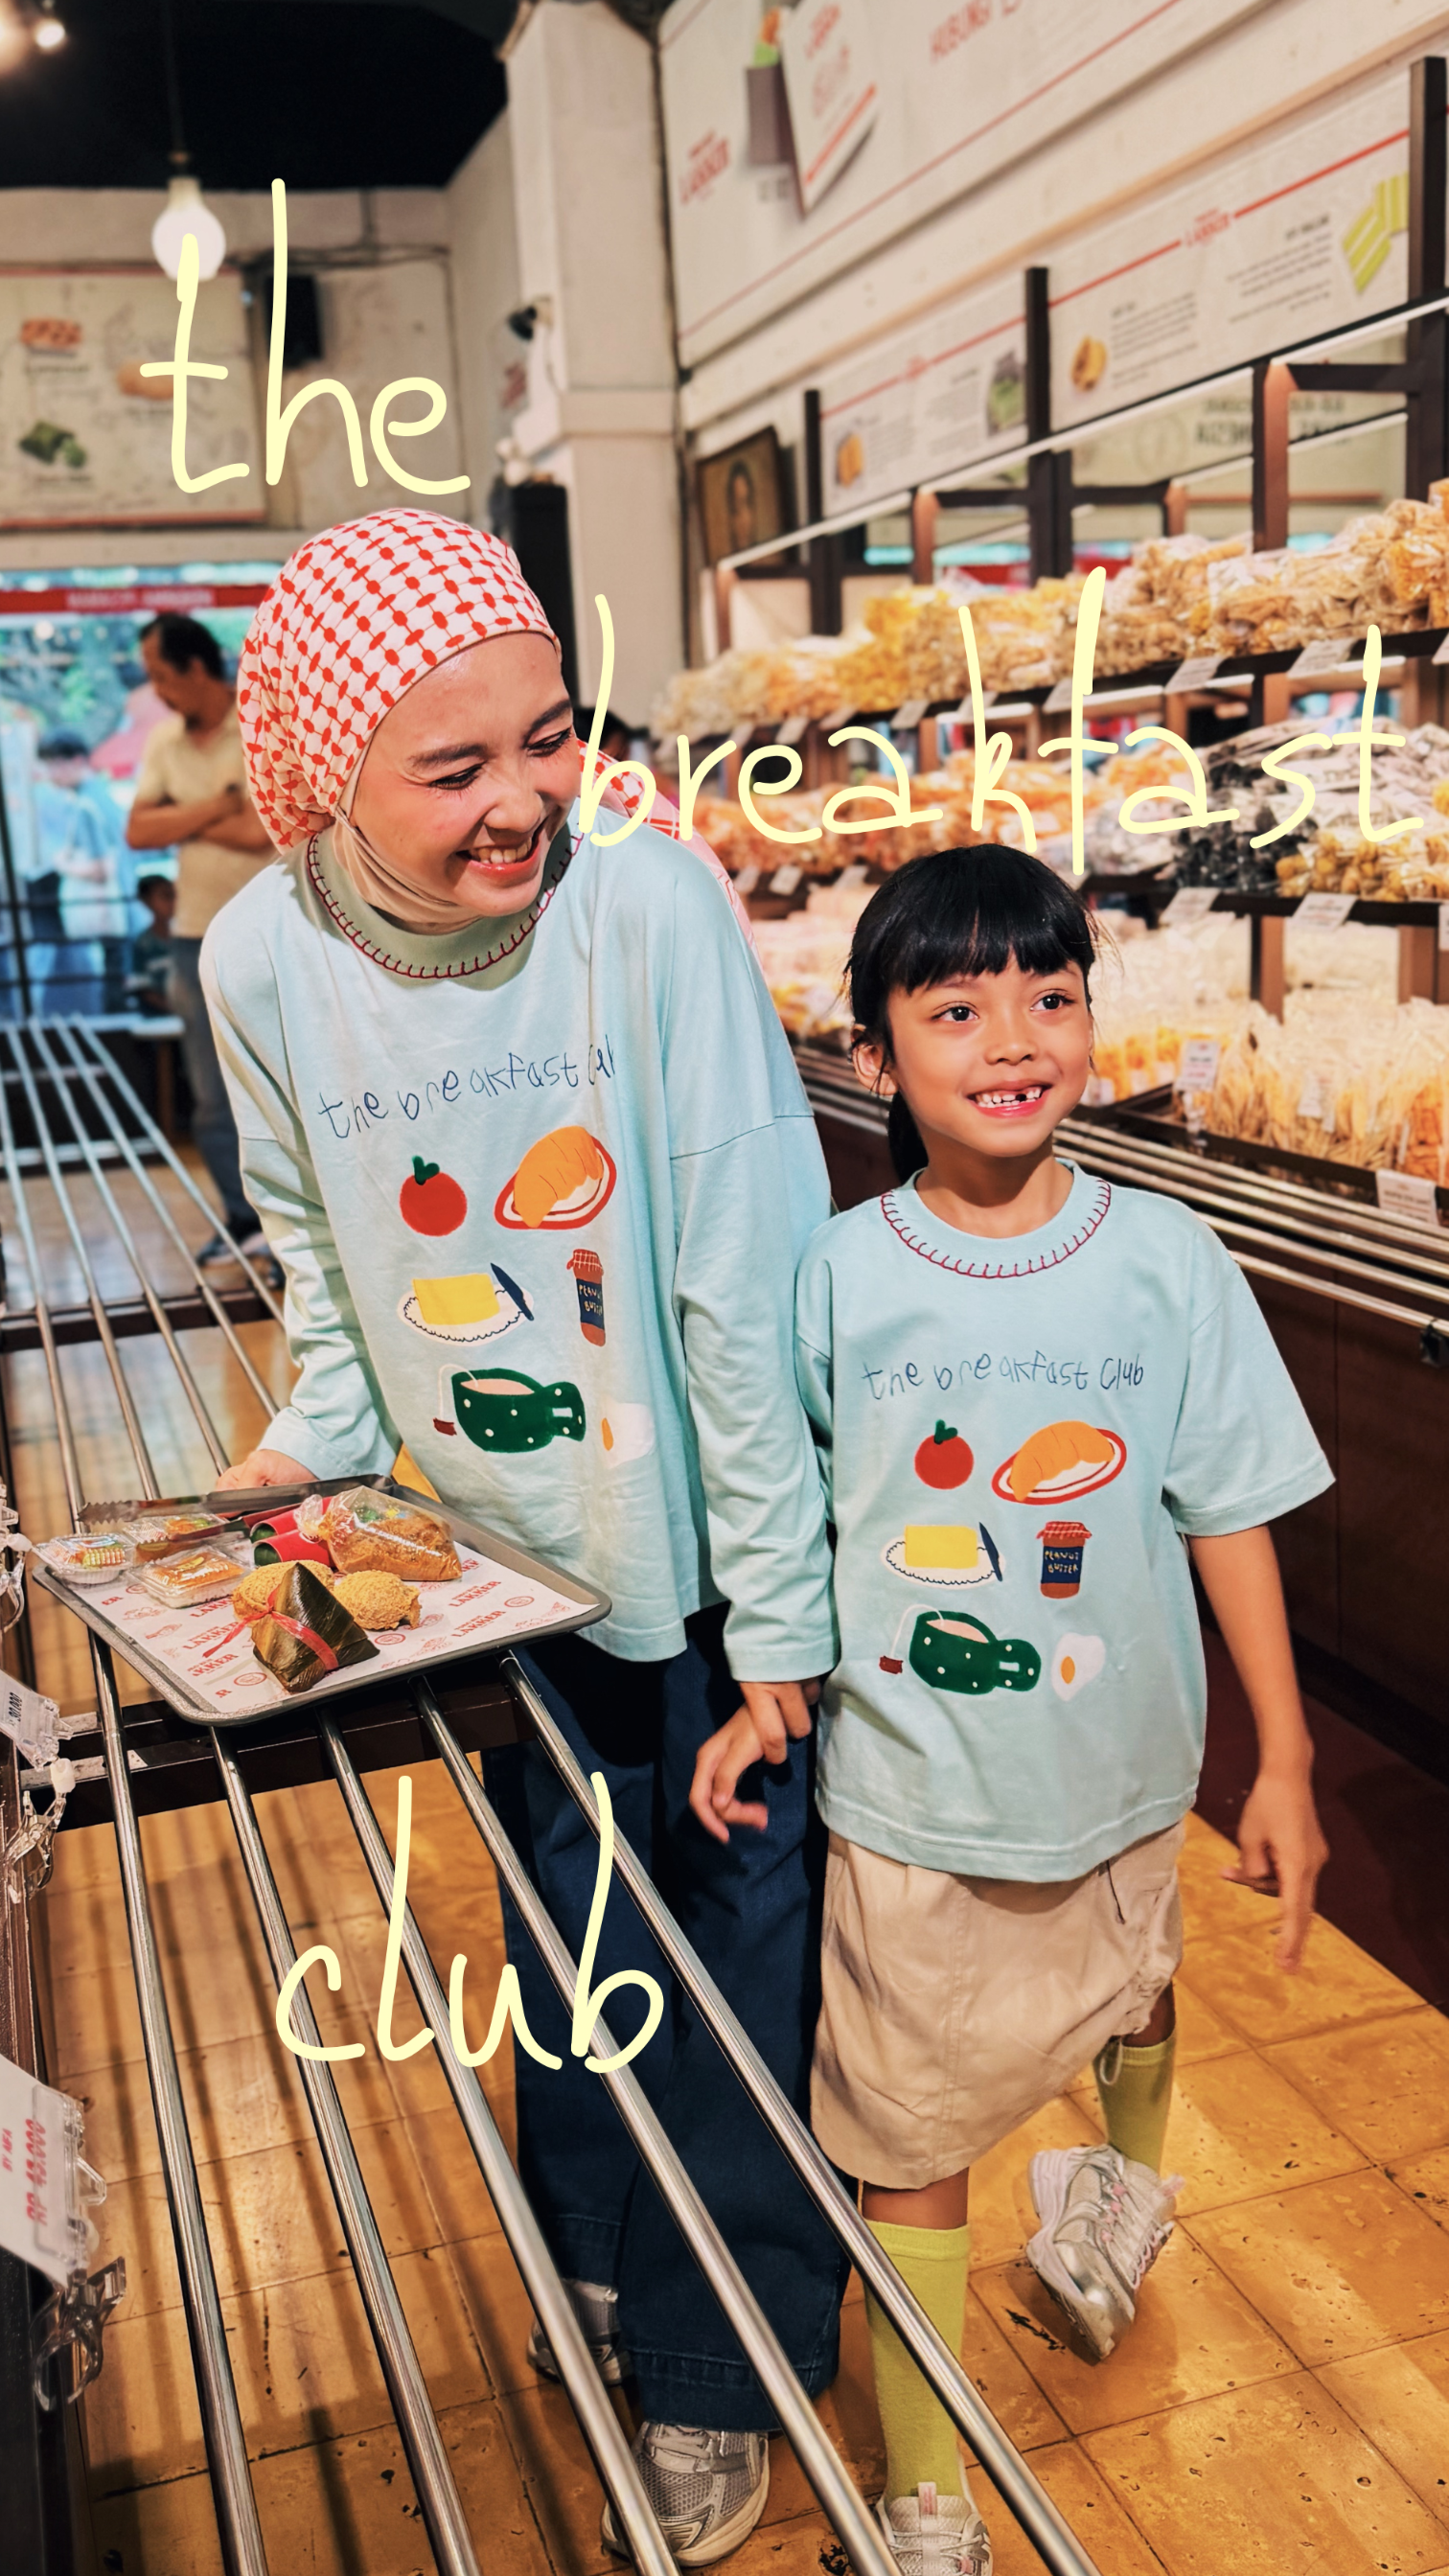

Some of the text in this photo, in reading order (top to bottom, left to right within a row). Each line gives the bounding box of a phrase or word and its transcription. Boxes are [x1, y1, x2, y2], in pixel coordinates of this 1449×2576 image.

[318, 1092, 389, 1138] the
[398, 1052, 579, 1120] breakfast
[861, 1362, 924, 1400] the
[933, 1350, 1089, 1391] breakfast
[1045, 1550, 1079, 1561] PEANUT
[1047, 1563, 1079, 1575] BUTTER
